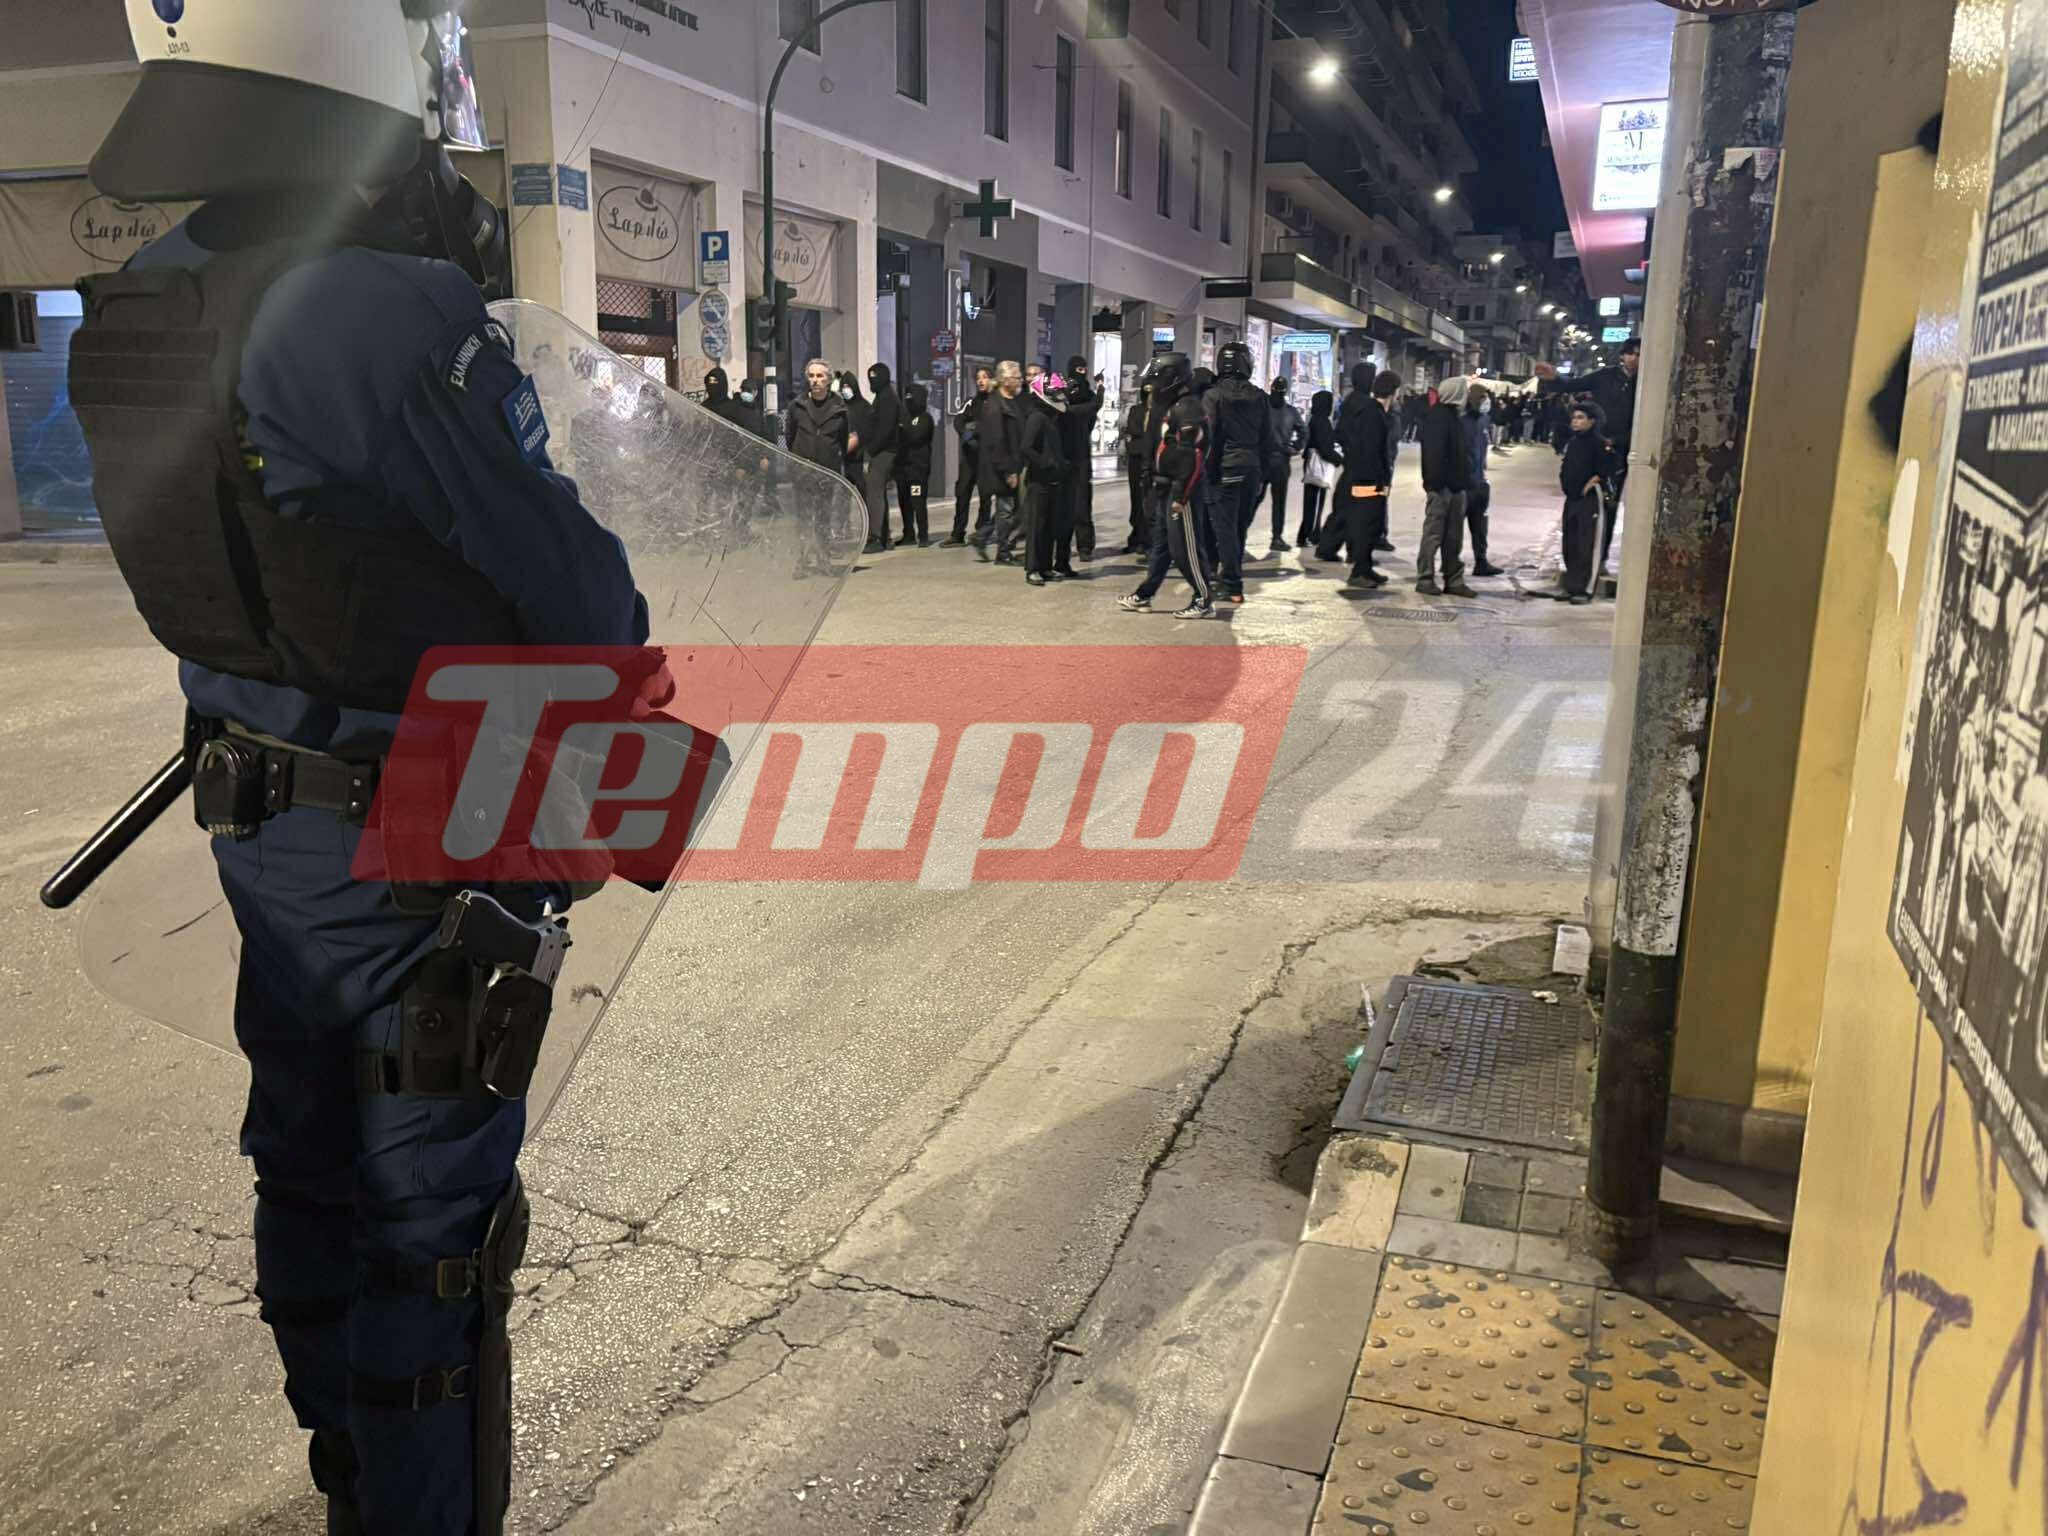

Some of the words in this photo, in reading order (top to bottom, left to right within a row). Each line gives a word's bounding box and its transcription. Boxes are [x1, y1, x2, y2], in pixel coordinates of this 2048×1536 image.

[707, 236, 722, 259] P
[1973, 287, 2027, 357] ΠΟΡΕΙΑ
[450, 333, 483, 389] ΕΛΛΗΝΙΚΗ
[523, 422, 546, 452] GREECE
